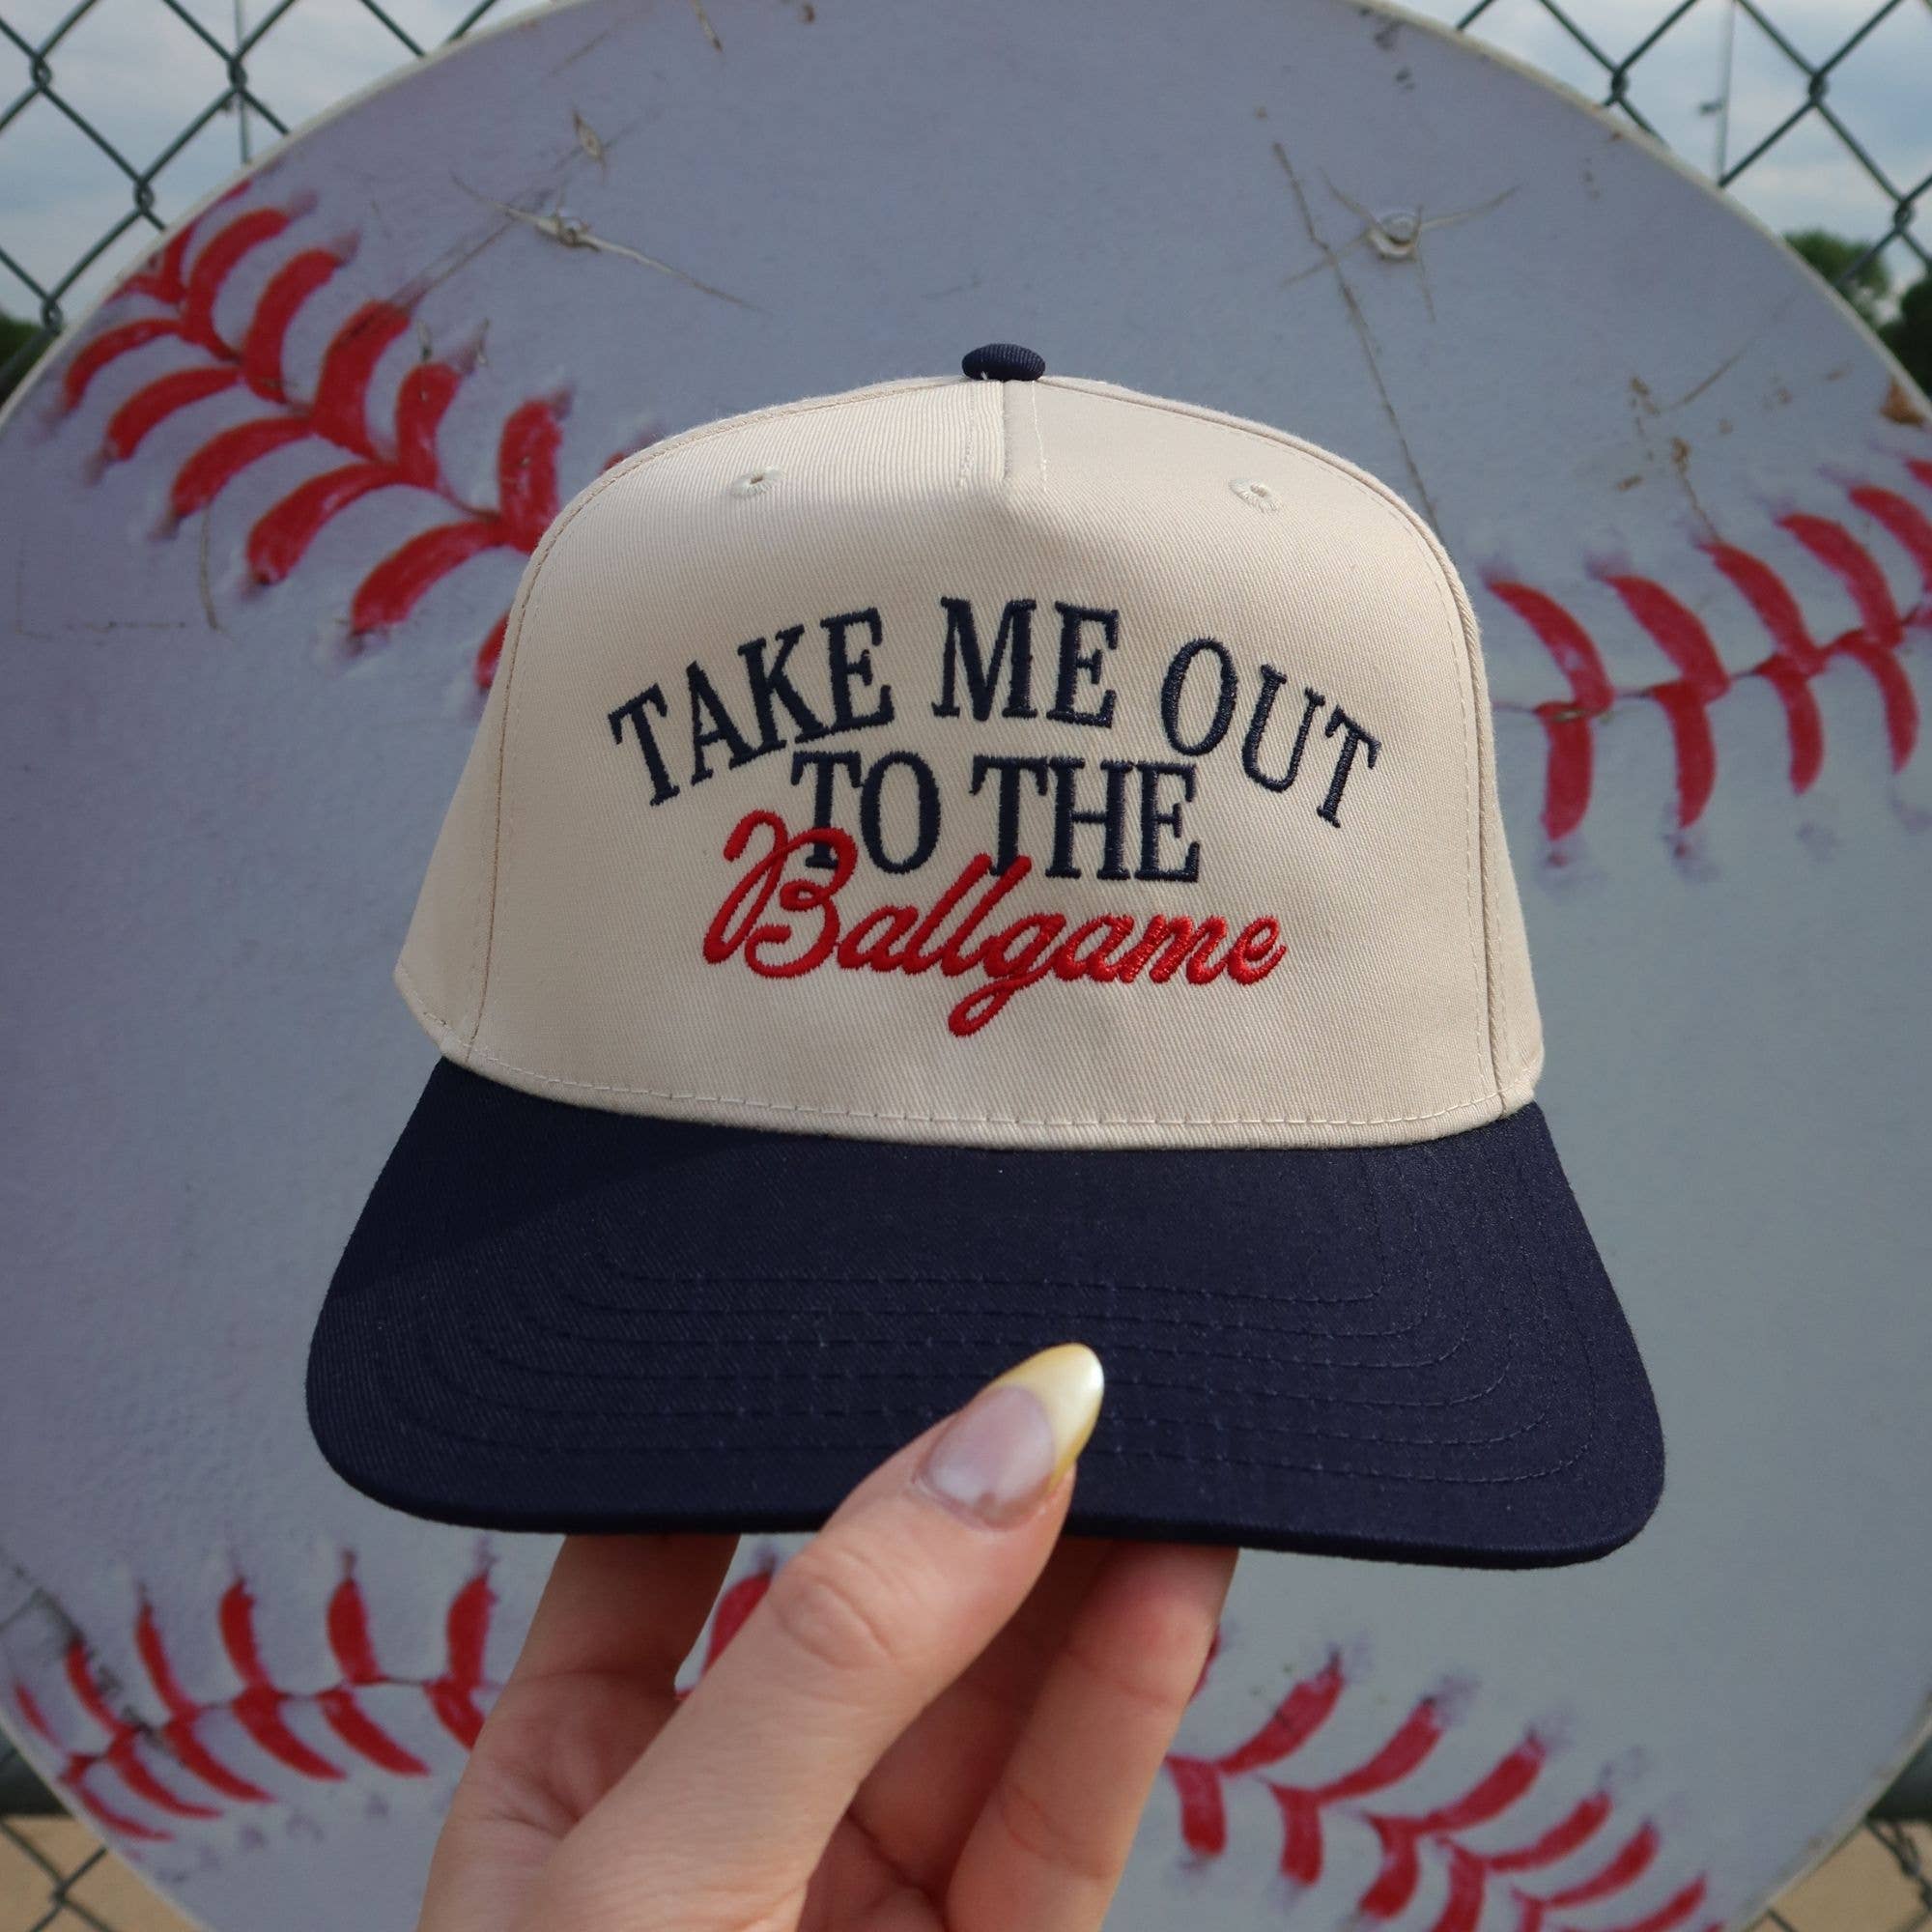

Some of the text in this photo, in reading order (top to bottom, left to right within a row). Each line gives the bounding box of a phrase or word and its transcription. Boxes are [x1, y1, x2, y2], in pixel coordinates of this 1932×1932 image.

[606, 595, 1382, 829] TAKE ME OUT
[789, 749, 1201, 885] TO THE
[702, 810, 1288, 1037] Ballgame
